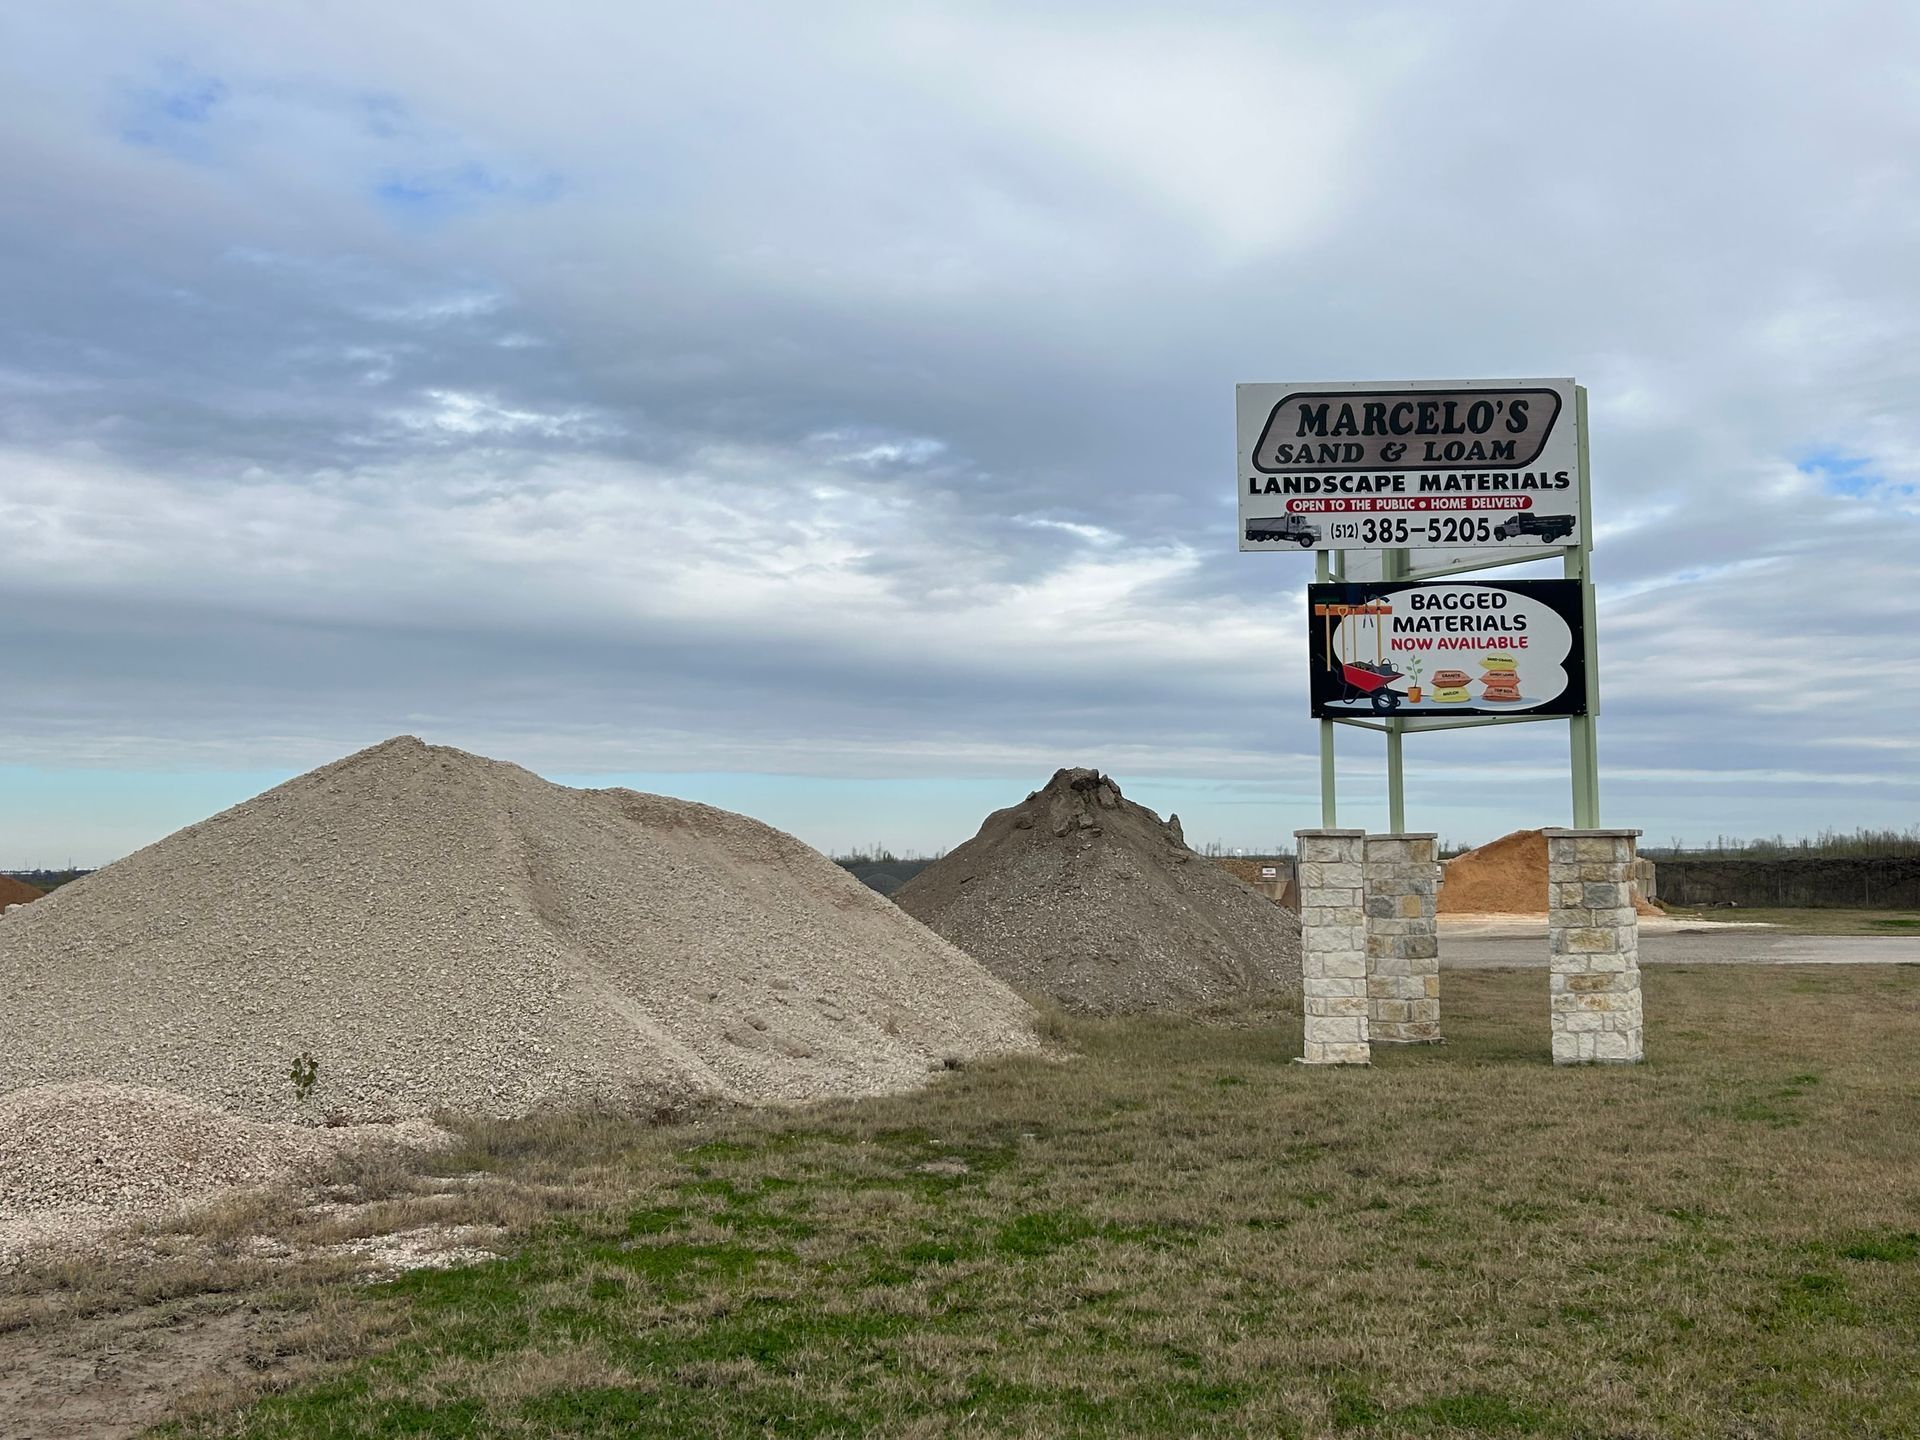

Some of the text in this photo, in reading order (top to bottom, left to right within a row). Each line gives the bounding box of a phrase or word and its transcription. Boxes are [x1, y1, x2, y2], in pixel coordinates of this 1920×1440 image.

[1296, 399, 1530, 438] MARCELO'S
[1274, 440, 1517, 465] SAND & LOAM
[1249, 471, 1571, 495] LANDSCAPE MATERIALS
[1292, 496, 1526, 512] OPEN TO THE PUBLIC HOME DELIVERY
[1330, 517, 1491, 544] (512) 385-5205
[1410, 592, 1507, 610] BAGGED
[1393, 614, 1527, 633] MATERIALS
[1391, 636, 1529, 651] NOW AVAILABLE
